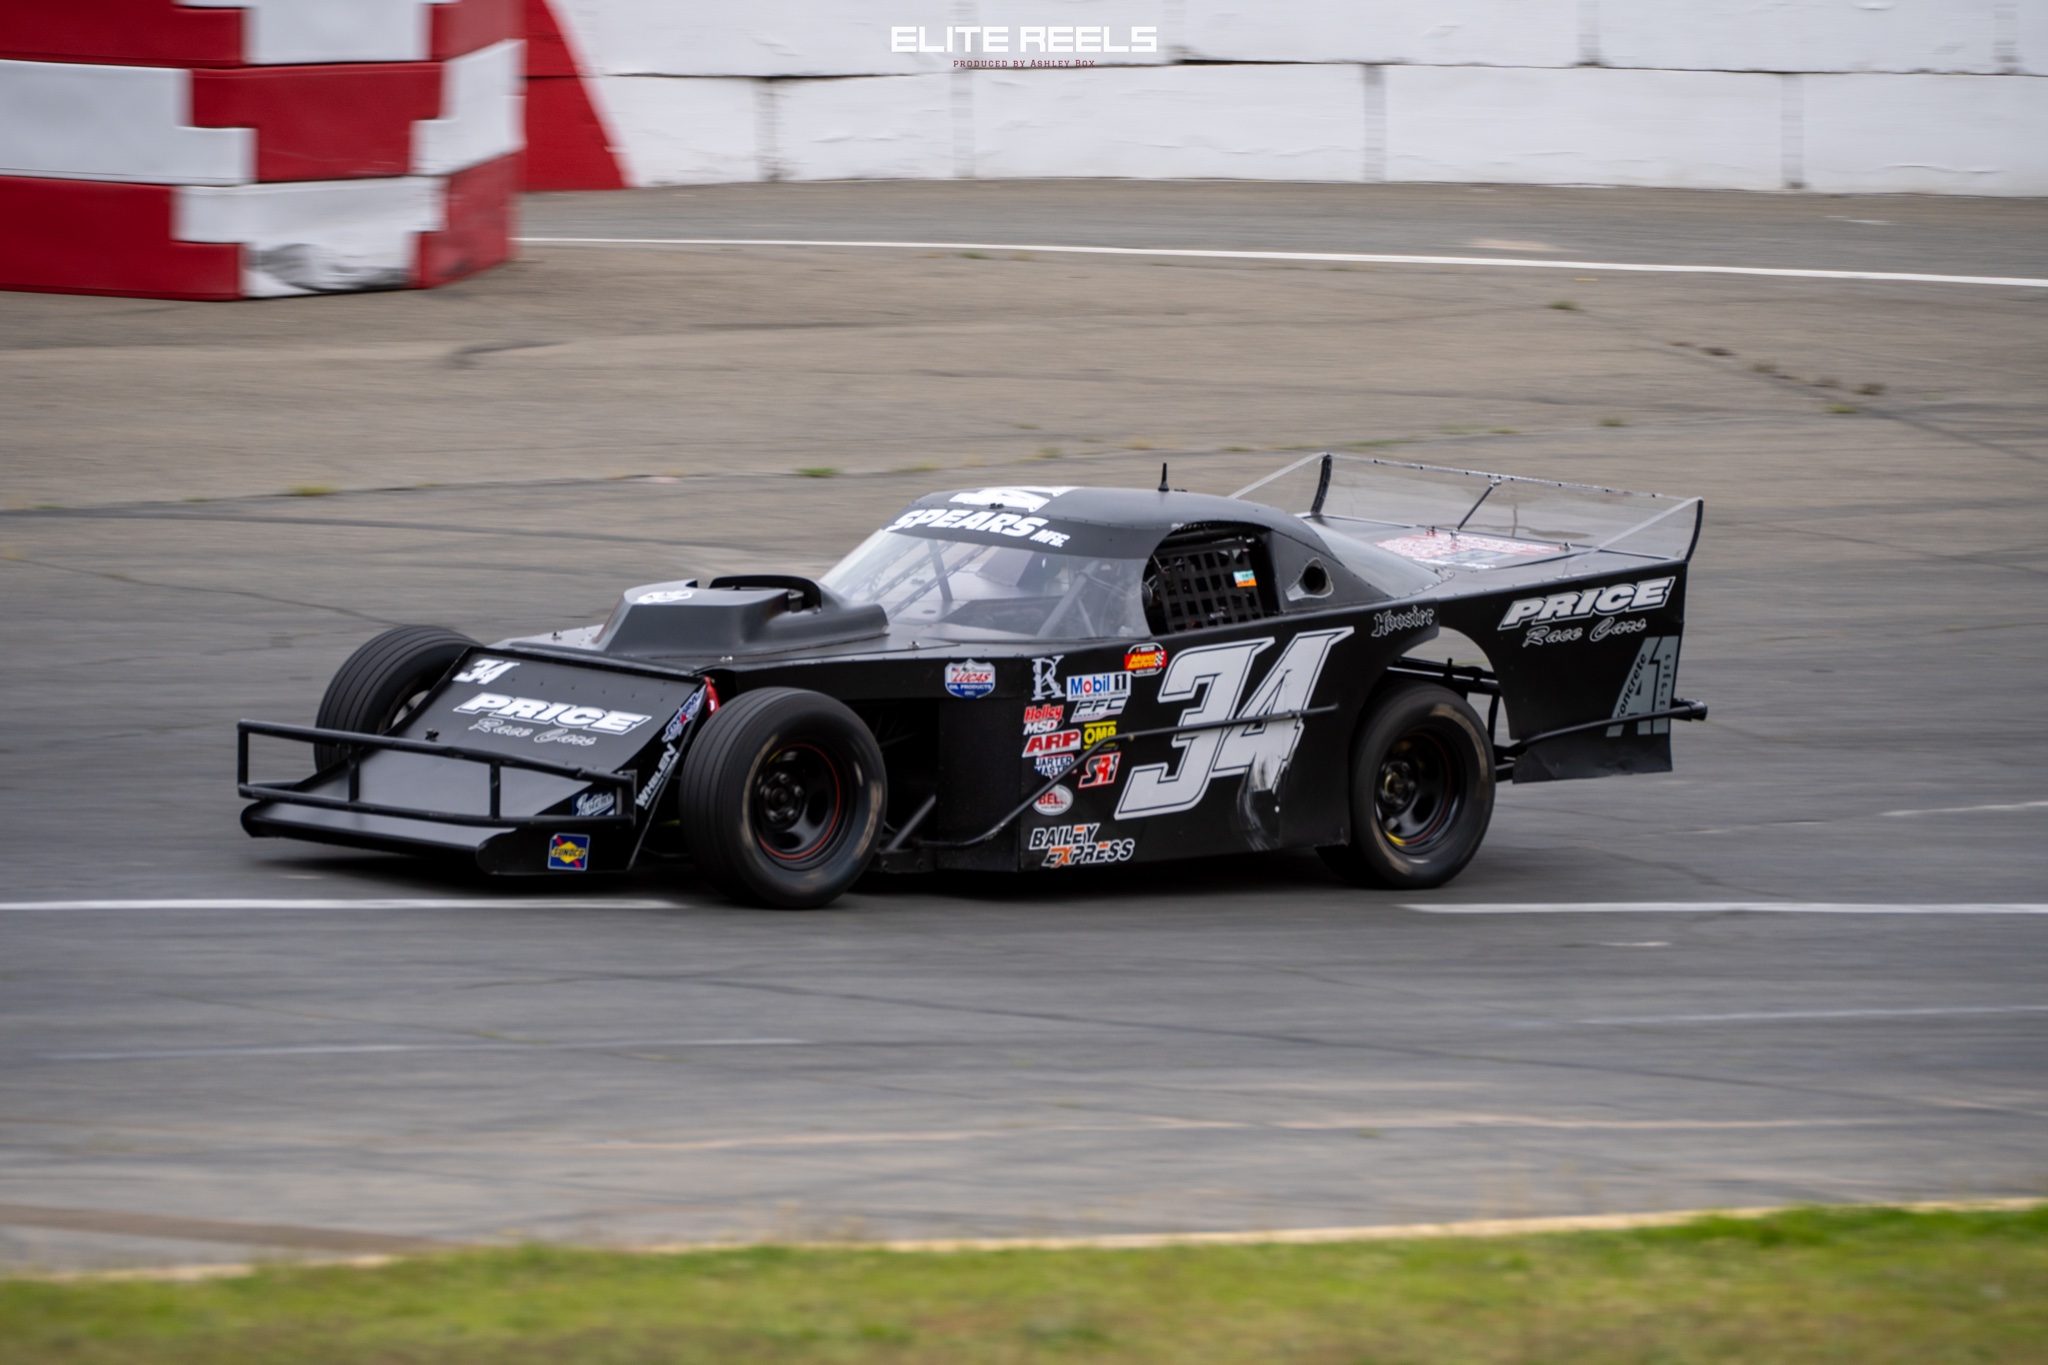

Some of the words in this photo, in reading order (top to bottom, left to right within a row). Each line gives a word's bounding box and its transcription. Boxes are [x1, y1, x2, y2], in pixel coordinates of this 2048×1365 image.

[883, 508, 1049, 538] SPEARS
[1497, 575, 1677, 632] PRICE
[1371, 604, 1435, 638] Hoosier
[1522, 625, 1583, 648] Race
[1589, 616, 1647, 643] Cars
[451, 658, 521, 686] 34
[952, 672, 992, 683] LUCAS
[1071, 675, 1110, 695] Mobil
[1617, 653, 1647, 718] oncrete
[453, 692, 652, 736] PRICE
[1024, 704, 1064, 723] Holley
[1076, 696, 1127, 714] PFC
[468, 717, 531, 738] Race
[1023, 720, 1058, 735] MSD
[1083, 725, 1117, 745] OMP
[1113, 625, 1355, 821] 34
[1025, 730, 1080, 754] ARP
[634, 742, 677, 808] WHELEN
[1034, 755, 1073, 767] UARTER
[1028, 822, 1101, 850] BAILEY
[551, 846, 587, 859] SUNOCO
[1041, 838, 1136, 868] EXPRESS
